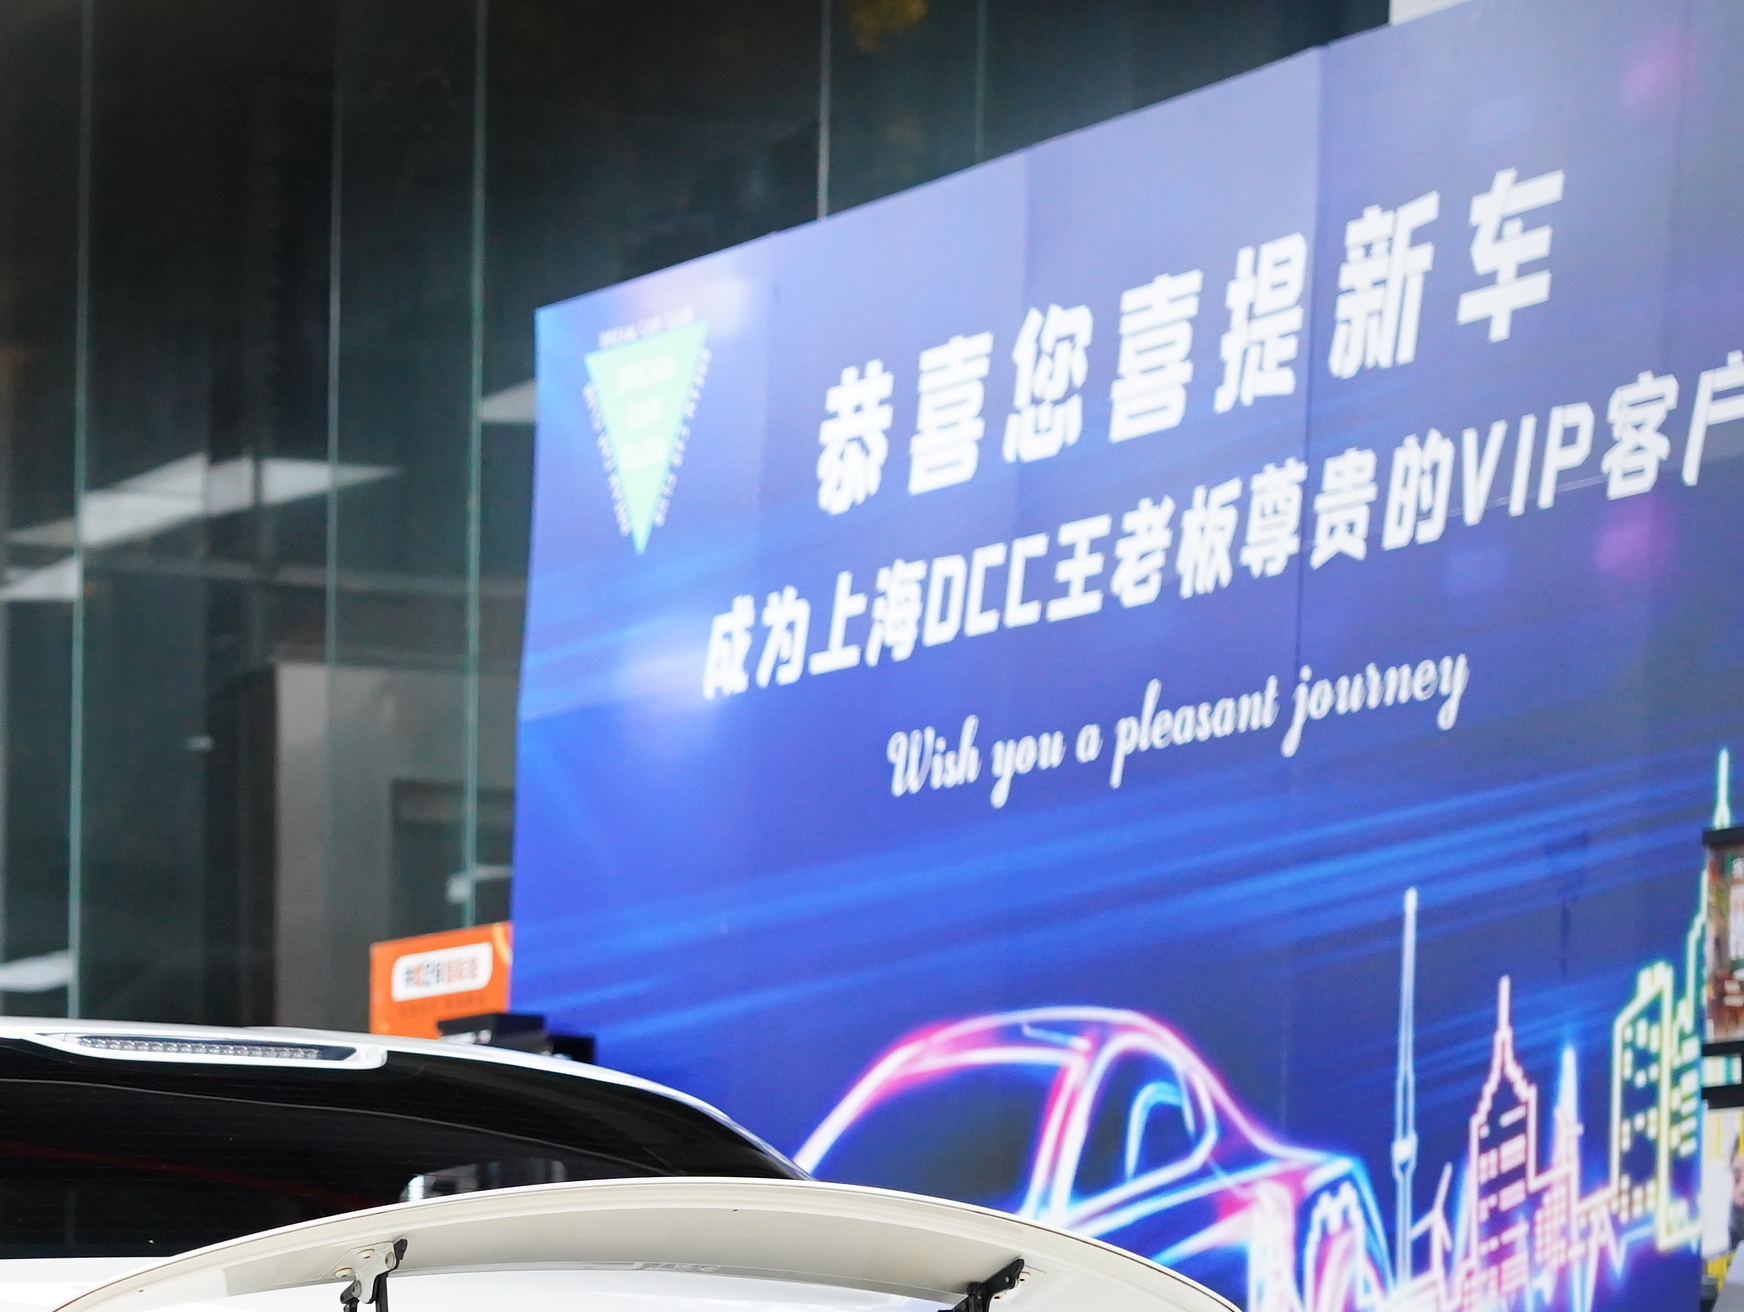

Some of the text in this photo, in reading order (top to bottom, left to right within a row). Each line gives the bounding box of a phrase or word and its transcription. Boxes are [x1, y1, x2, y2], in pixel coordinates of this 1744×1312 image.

[817, 167, 1565, 516] 恭喜您喜提新车
[886, 653, 1471, 809] Wish you a pleasant journey
